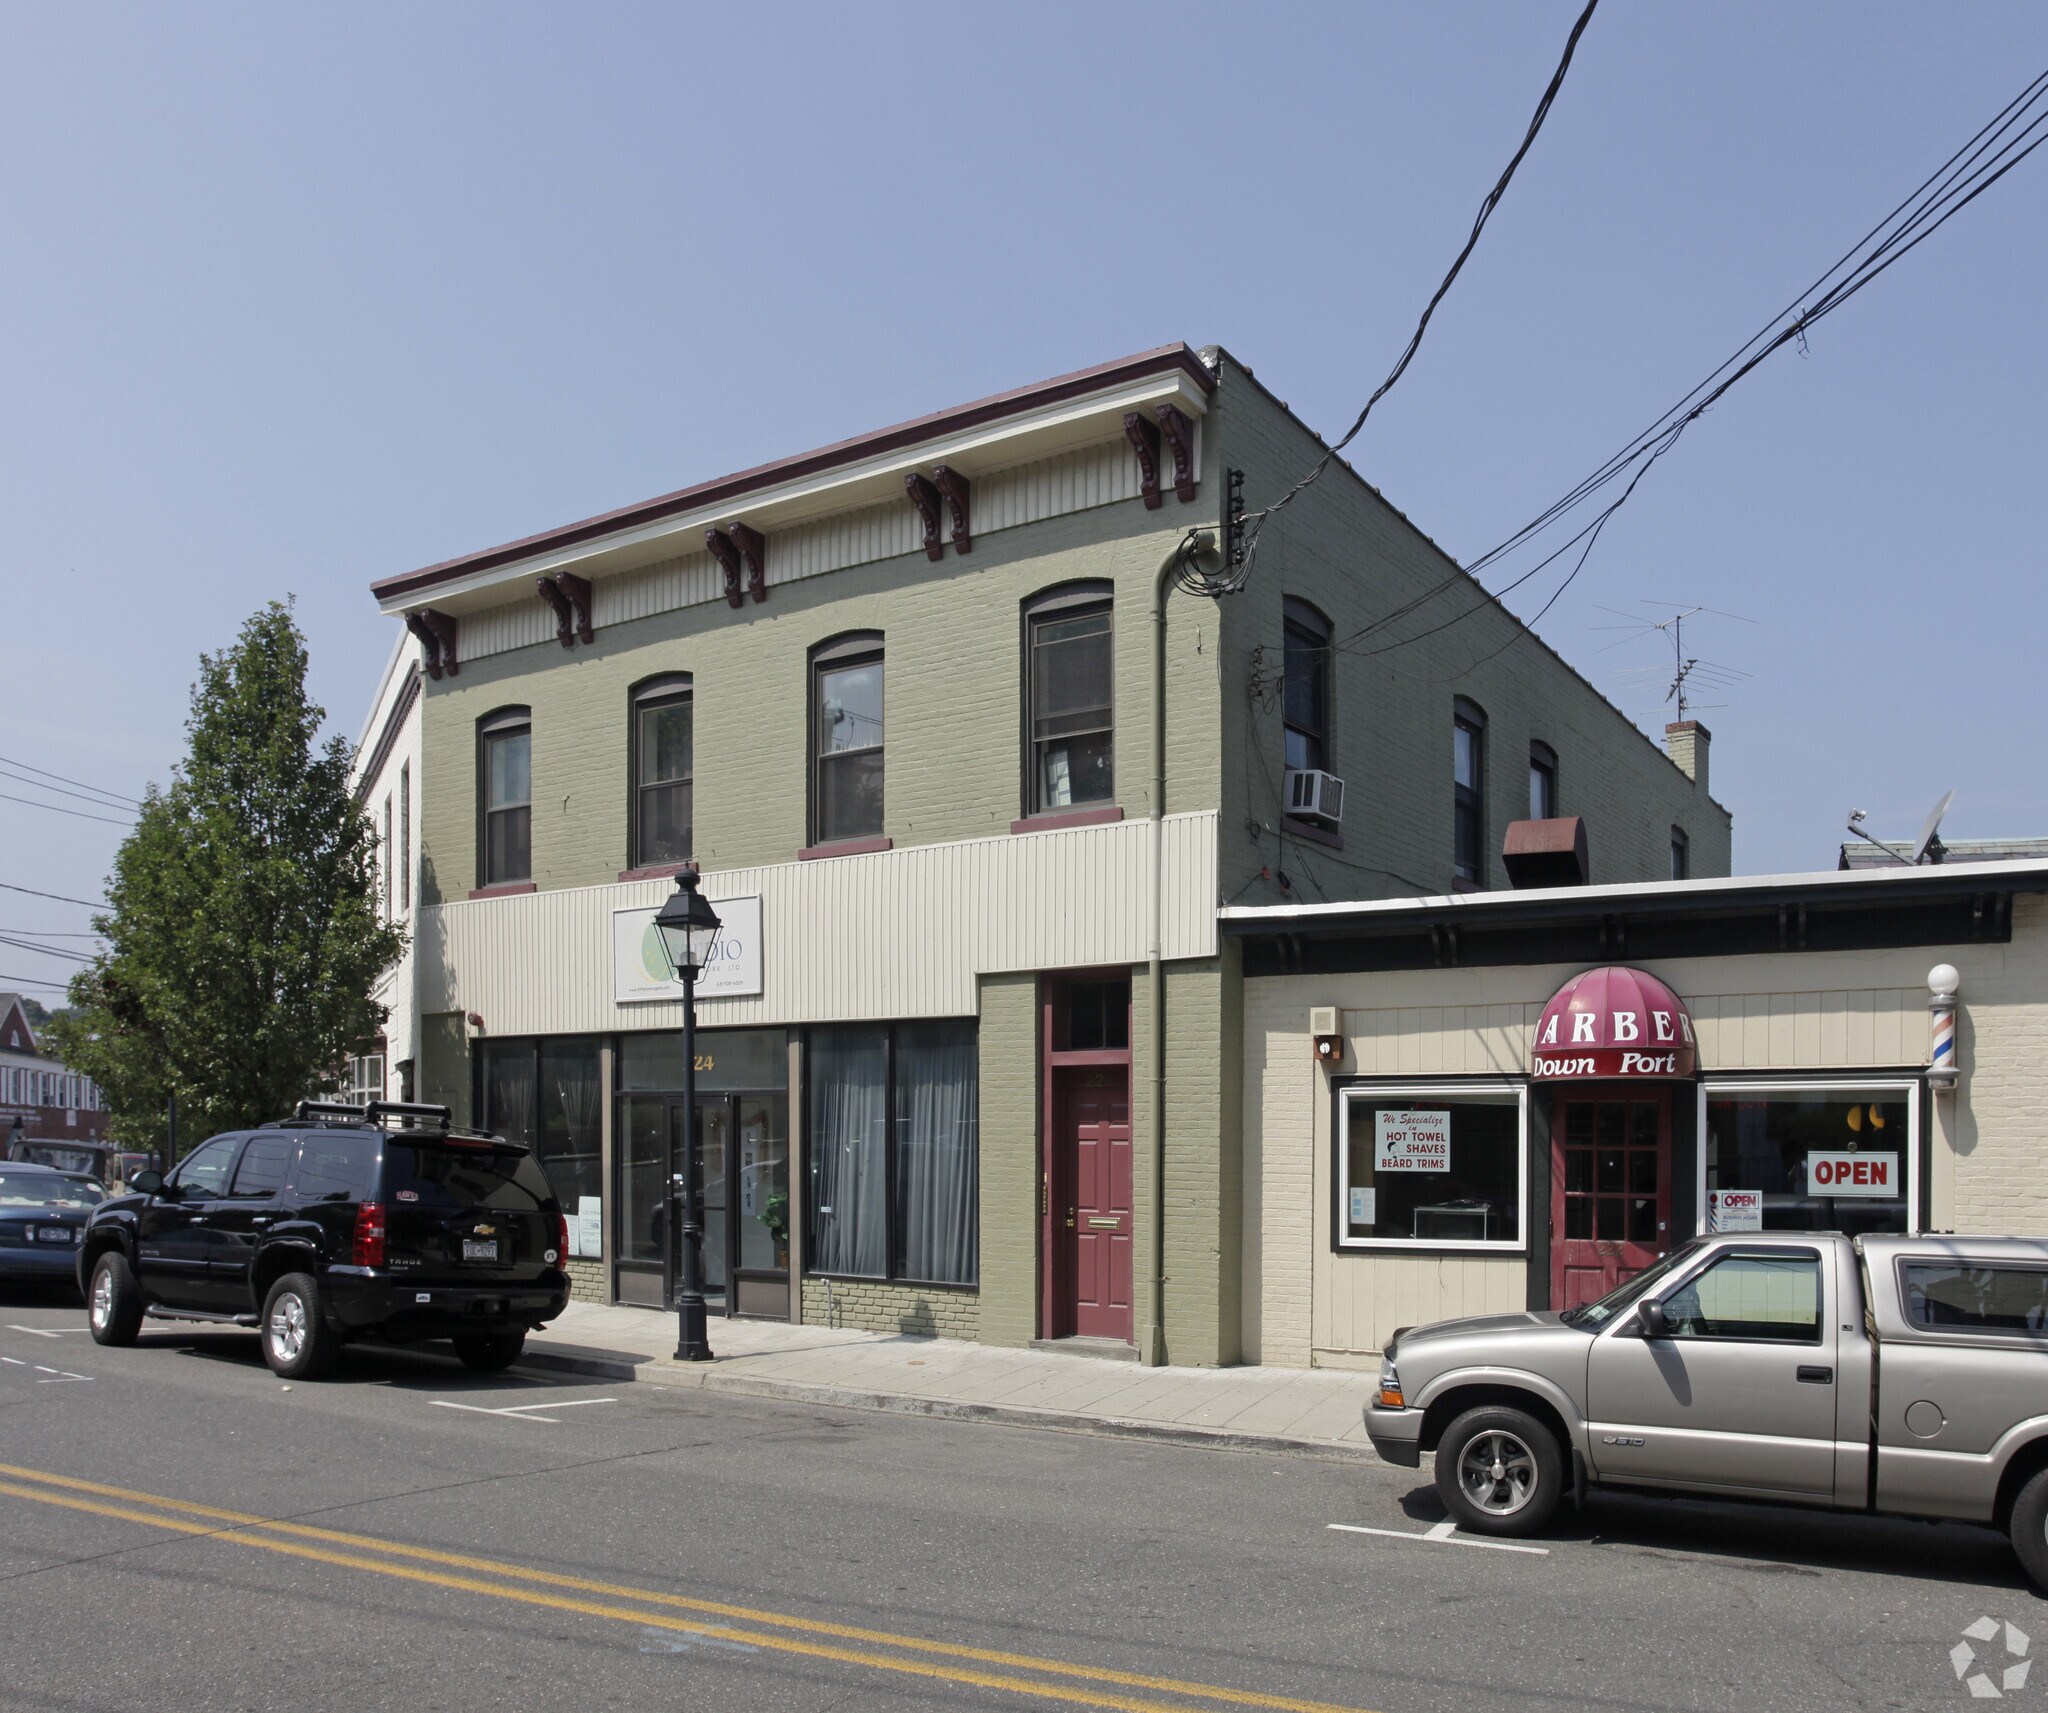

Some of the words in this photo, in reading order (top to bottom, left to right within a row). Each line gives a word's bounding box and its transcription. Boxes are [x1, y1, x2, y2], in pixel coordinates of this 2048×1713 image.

[1532, 1011, 1694, 1048] ARBER
[1533, 1057, 1596, 1077] Down
[1619, 1052, 1676, 1074] Port
[1383, 1113, 1396, 1124] We
[1399, 1113, 1443, 1128] Specialize
[1386, 1132, 1407, 1141] HOT
[1412, 1132, 1446, 1142] TOWEL
[1406, 1144, 1446, 1154] SHAVES
[1382, 1158, 1412, 1168] BEARD
[1417, 1159, 1445, 1169] TRIMS
[1815, 1160, 1887, 1185] OPEN
[1724, 1194, 1757, 1207] OPEN
